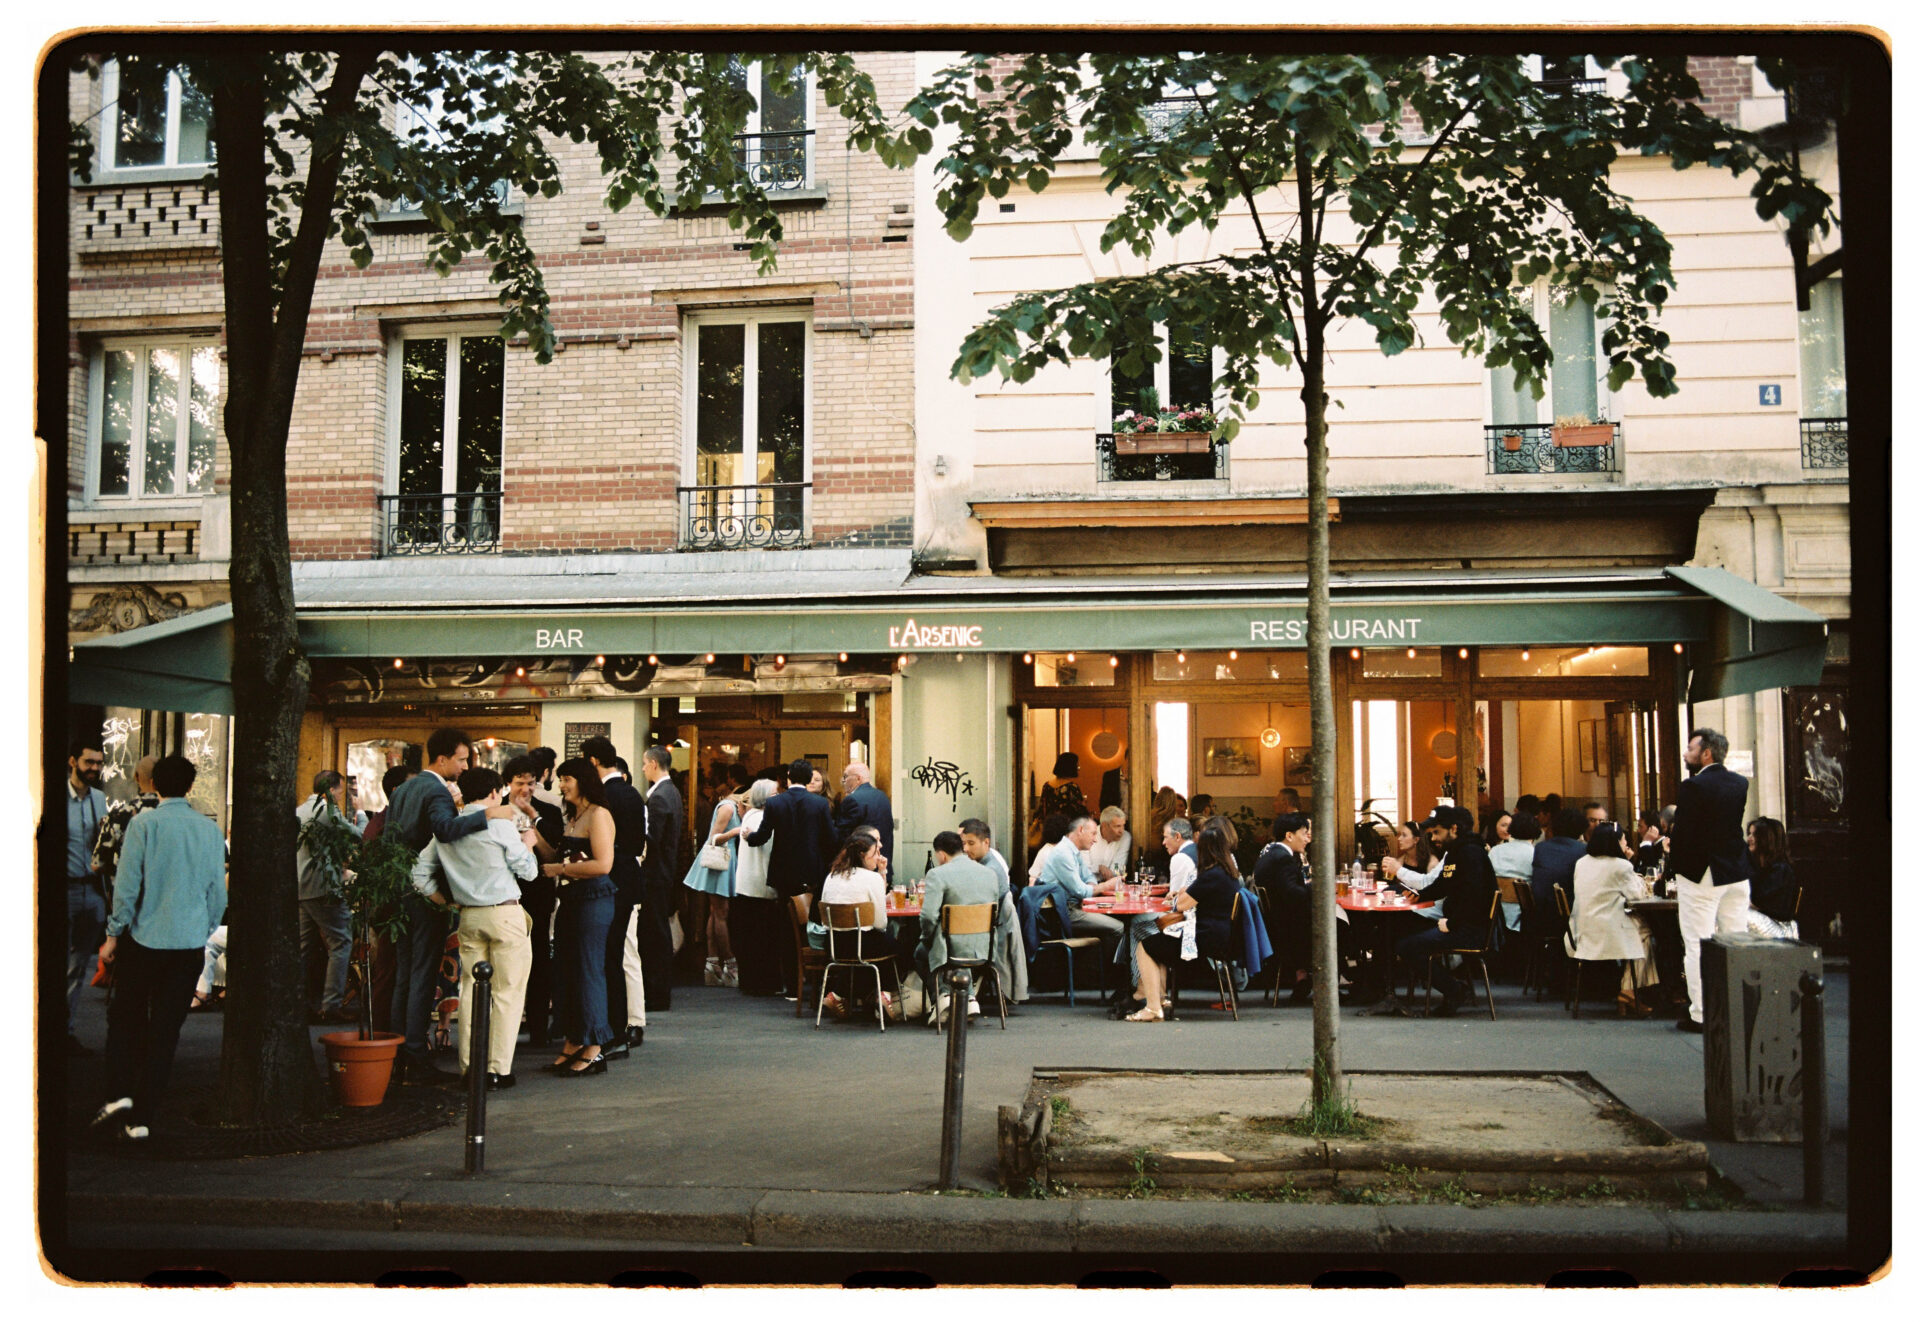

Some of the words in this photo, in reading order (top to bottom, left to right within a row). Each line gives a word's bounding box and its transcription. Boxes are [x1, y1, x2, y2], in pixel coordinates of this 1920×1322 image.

[1764, 386, 1776, 403] 4
[124, 609, 134, 626] 6
[536, 629, 584, 648] BAR
[1250, 618, 1422, 641] RESURANT
